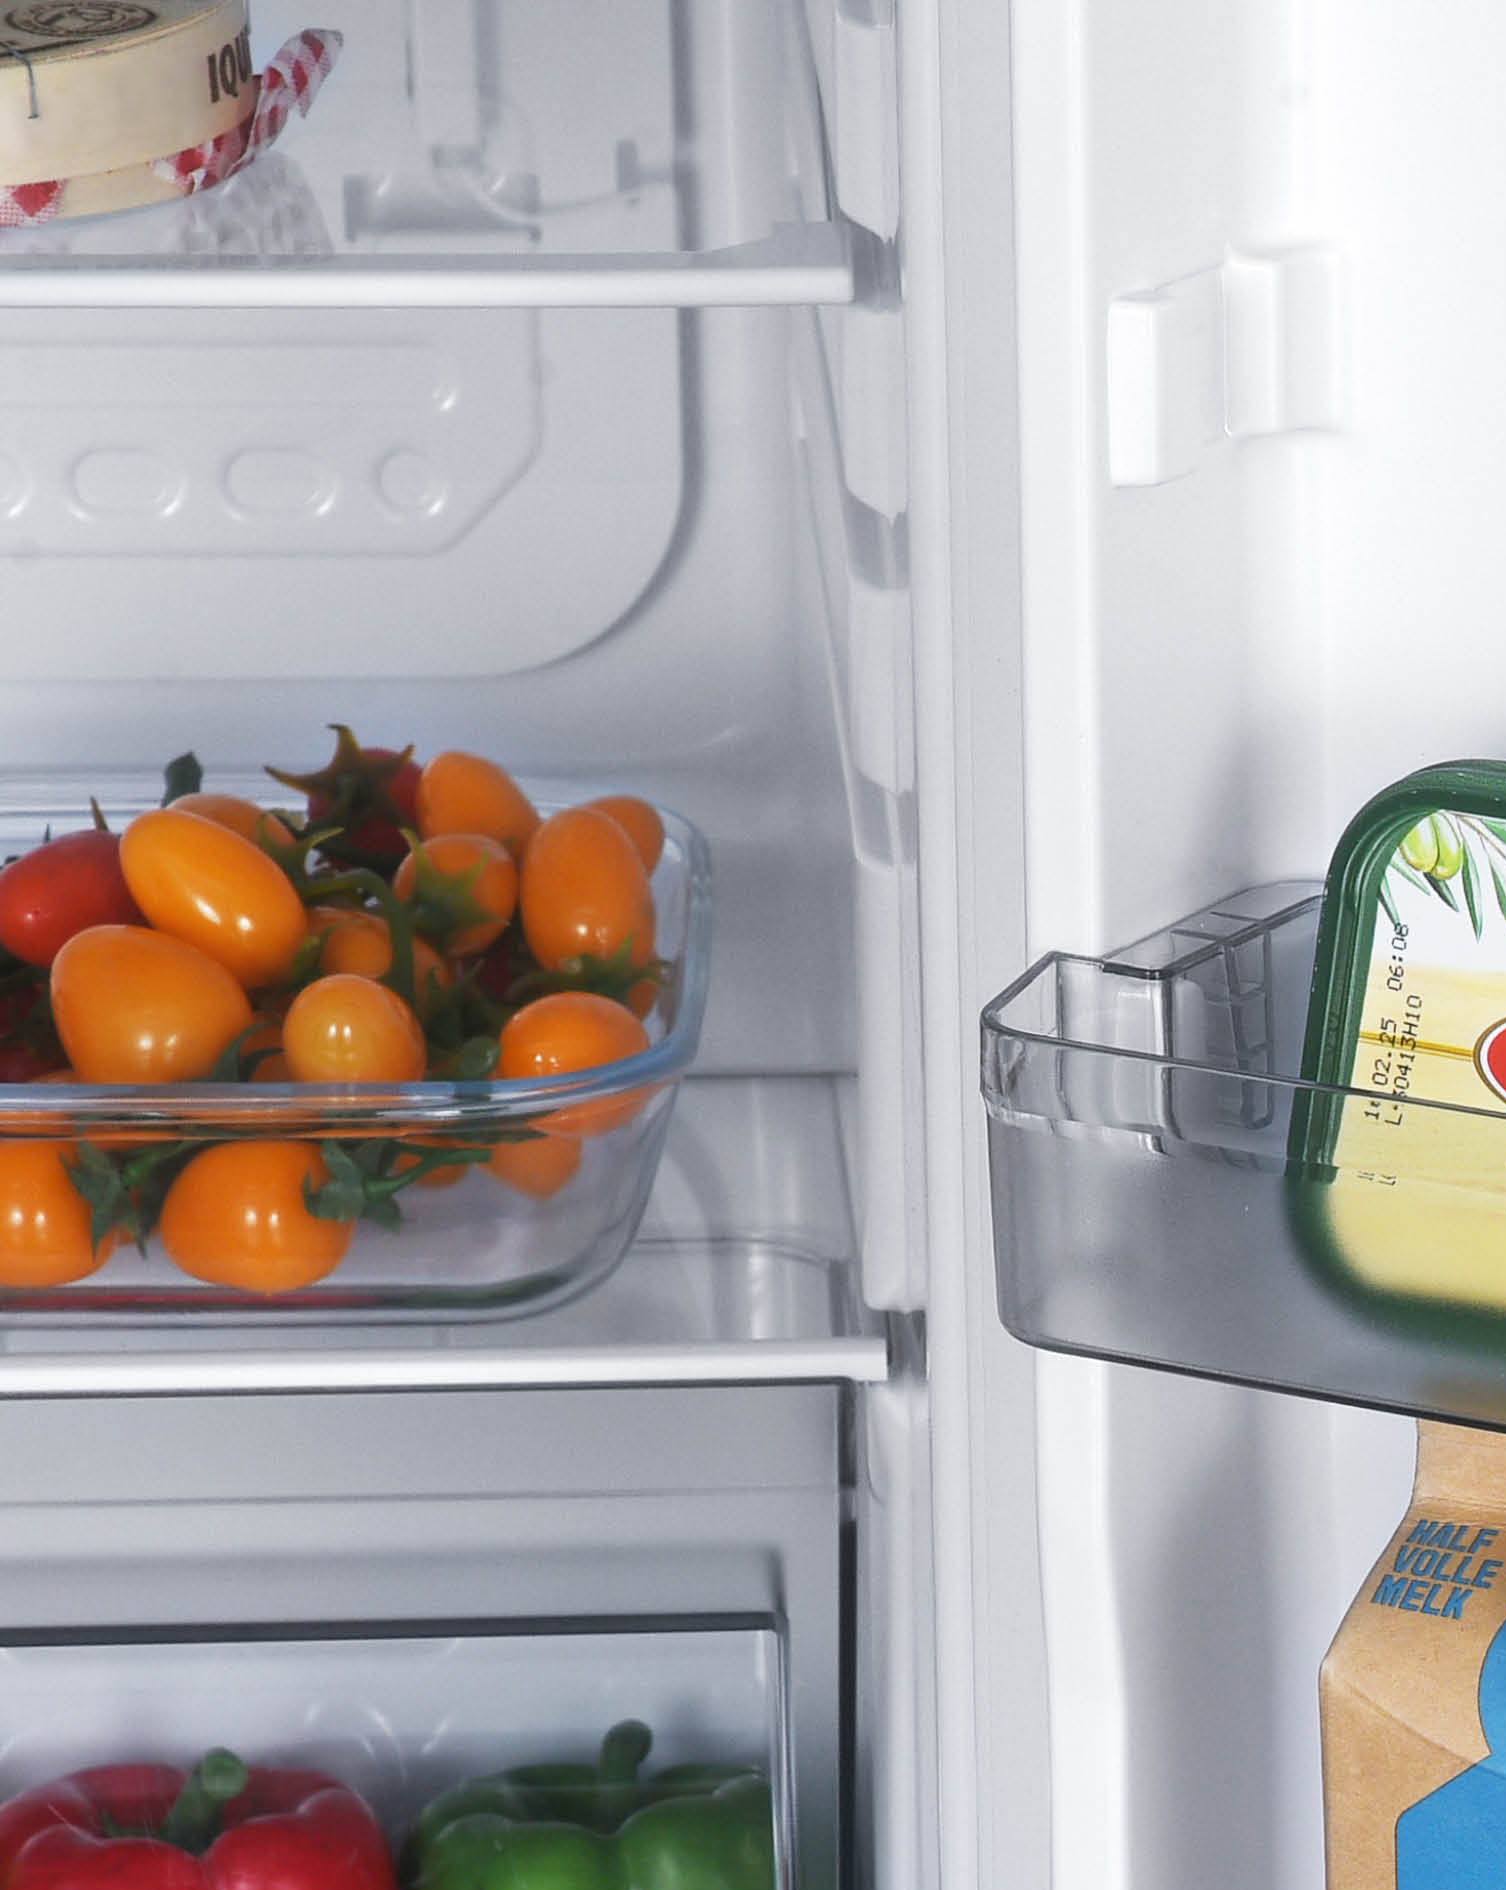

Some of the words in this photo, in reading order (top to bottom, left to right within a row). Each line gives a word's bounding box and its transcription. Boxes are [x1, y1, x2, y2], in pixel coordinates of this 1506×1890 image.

[1406, 1518, 1500, 1554] HALF
[1392, 1545, 1505, 1590] VOLLE
[1371, 1573, 1474, 1620] MELK
